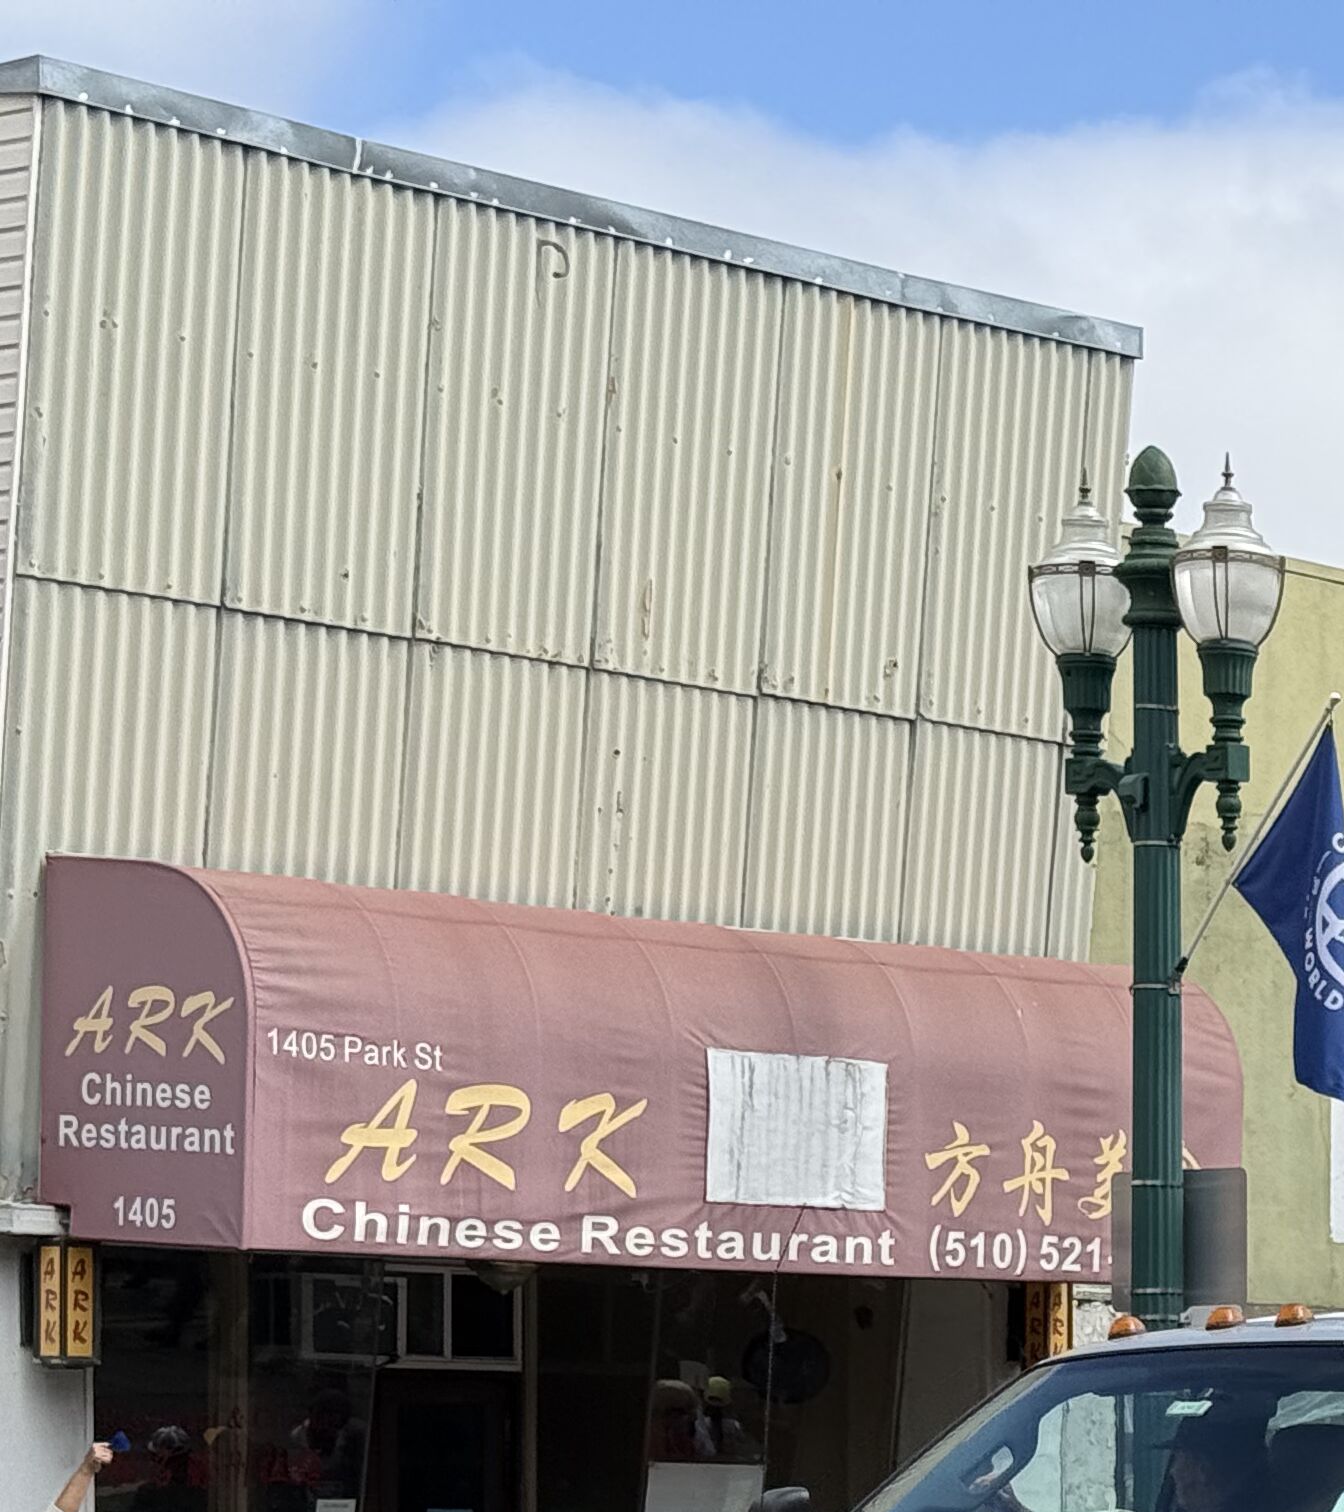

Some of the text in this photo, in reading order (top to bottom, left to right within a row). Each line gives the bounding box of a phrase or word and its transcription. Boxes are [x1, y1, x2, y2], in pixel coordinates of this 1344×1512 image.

[1303, 927, 1344, 1011] WORLD
[66, 985, 234, 1065] ARK
[267, 1028, 443, 1071] 1405 Park St
[81, 1073, 211, 1110] Chinese
[58, 1114, 234, 1156] Restaurant
[325, 1079, 647, 1199] ARK
[113, 1197, 176, 1230] 1405
[302, 1199, 1112, 1276] Chinese Restaurant (510) 521
[43, 1256, 58, 1345] ARK
[72, 1257, 89, 1345] ARK
